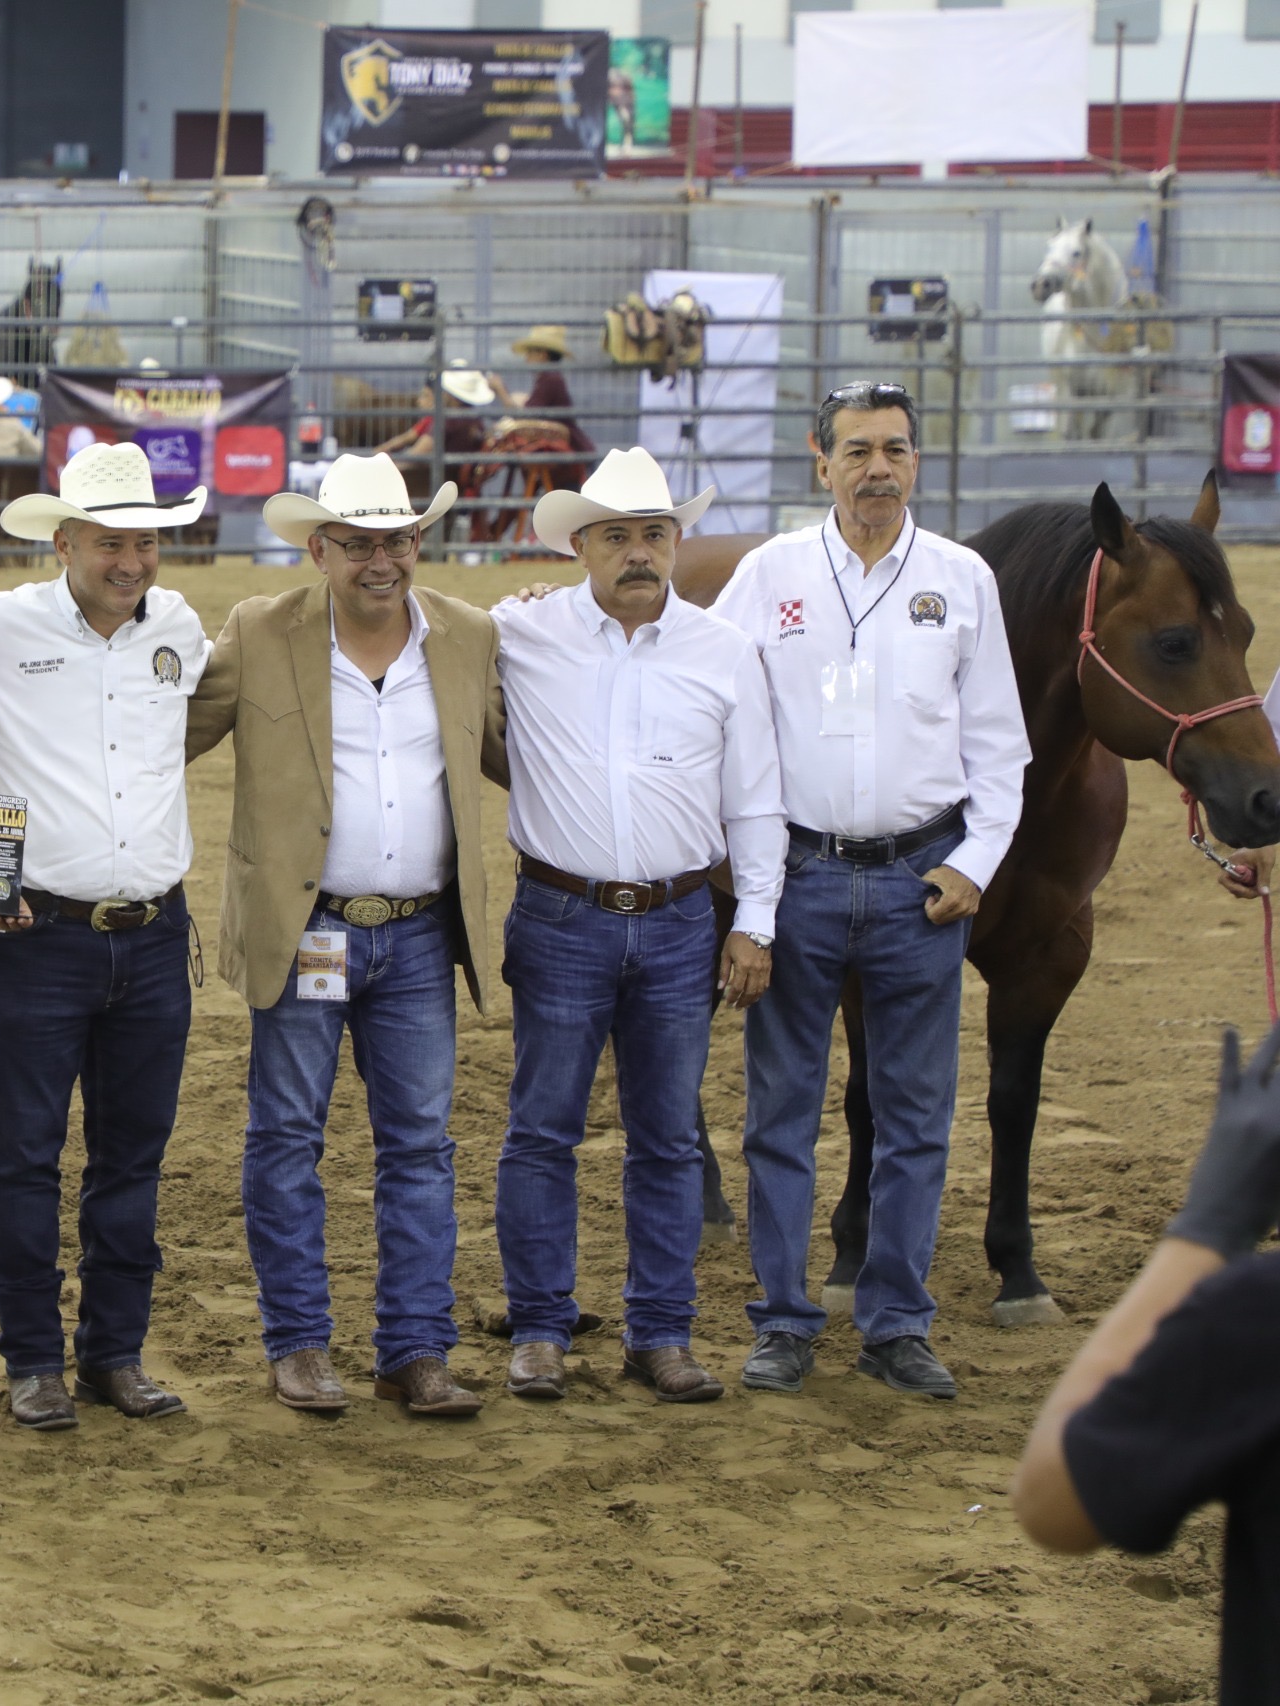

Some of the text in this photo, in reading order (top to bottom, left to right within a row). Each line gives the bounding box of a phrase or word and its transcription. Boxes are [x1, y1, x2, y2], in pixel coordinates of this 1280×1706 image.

[389, 62, 432, 86] TONY
[433, 62, 473, 88] DIAZ
[24, 666, 59, 674] PRESIDENTE
